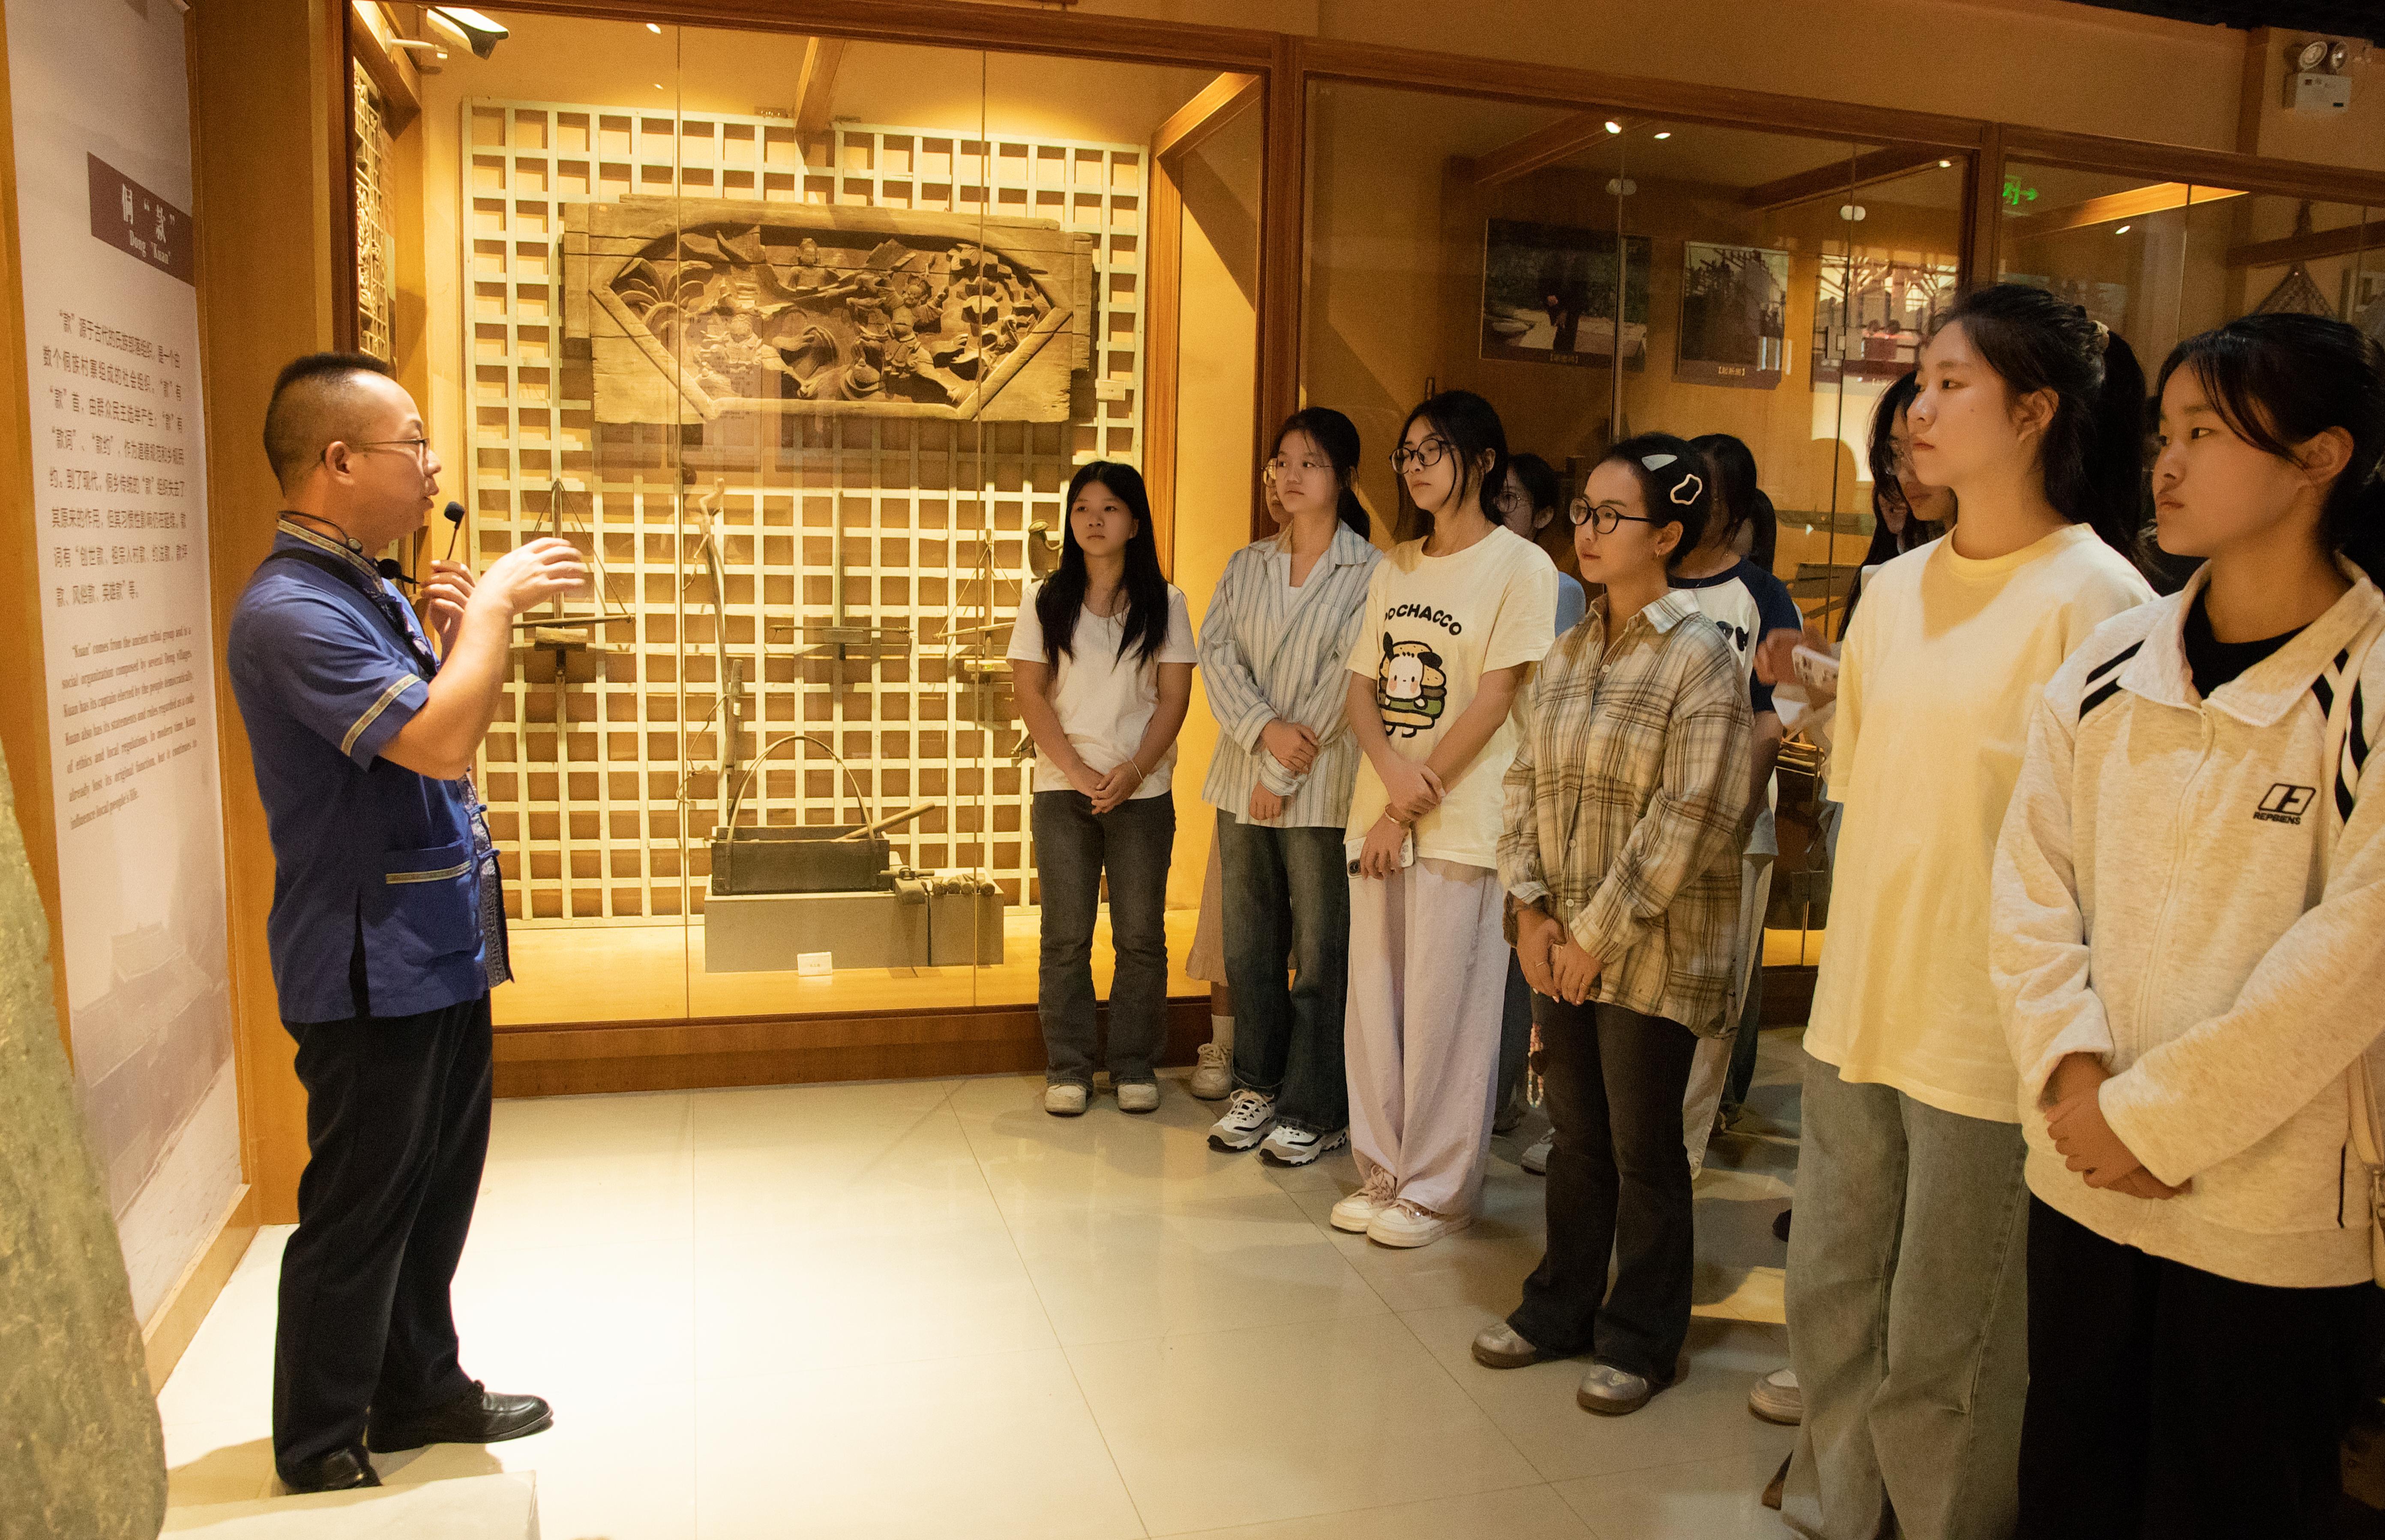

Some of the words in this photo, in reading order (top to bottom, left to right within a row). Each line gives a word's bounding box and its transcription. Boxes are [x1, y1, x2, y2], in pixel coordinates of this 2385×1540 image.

[129, 229, 147, 258] Dong
[1384, 603, 1462, 636] OCHACCO
[93, 643, 109, 654] comes
[110, 638, 122, 650] from
[123, 636, 131, 648] the
[163, 630, 174, 643] group
[62, 674, 78, 689] social
[81, 667, 114, 687] organization
[116, 659, 139, 677] composed
[148, 657, 163, 668] several
[165, 653, 175, 665] Dong
[63, 704, 79, 717] Kuan
[79, 701, 89, 713] has
[98, 692, 117, 710] captain
[117, 686, 134, 701] elected
[150, 681, 163, 695] people
[65, 732, 81, 746] Kuan
[81, 727, 92, 740] also
[93, 724, 102, 736] has
[111, 714, 137, 730] statements
[137, 708, 146, 721] and
[159, 698, 177, 713] regarded
[75, 755, 92, 770] ethics
[95, 749, 104, 763] and
[107, 743, 119, 758] local
[69, 783, 90, 802] already
[92, 779, 102, 791] lost
[114, 763, 134, 783] original
[70, 810, 96, 830] influence
[96, 801, 110, 818] local
